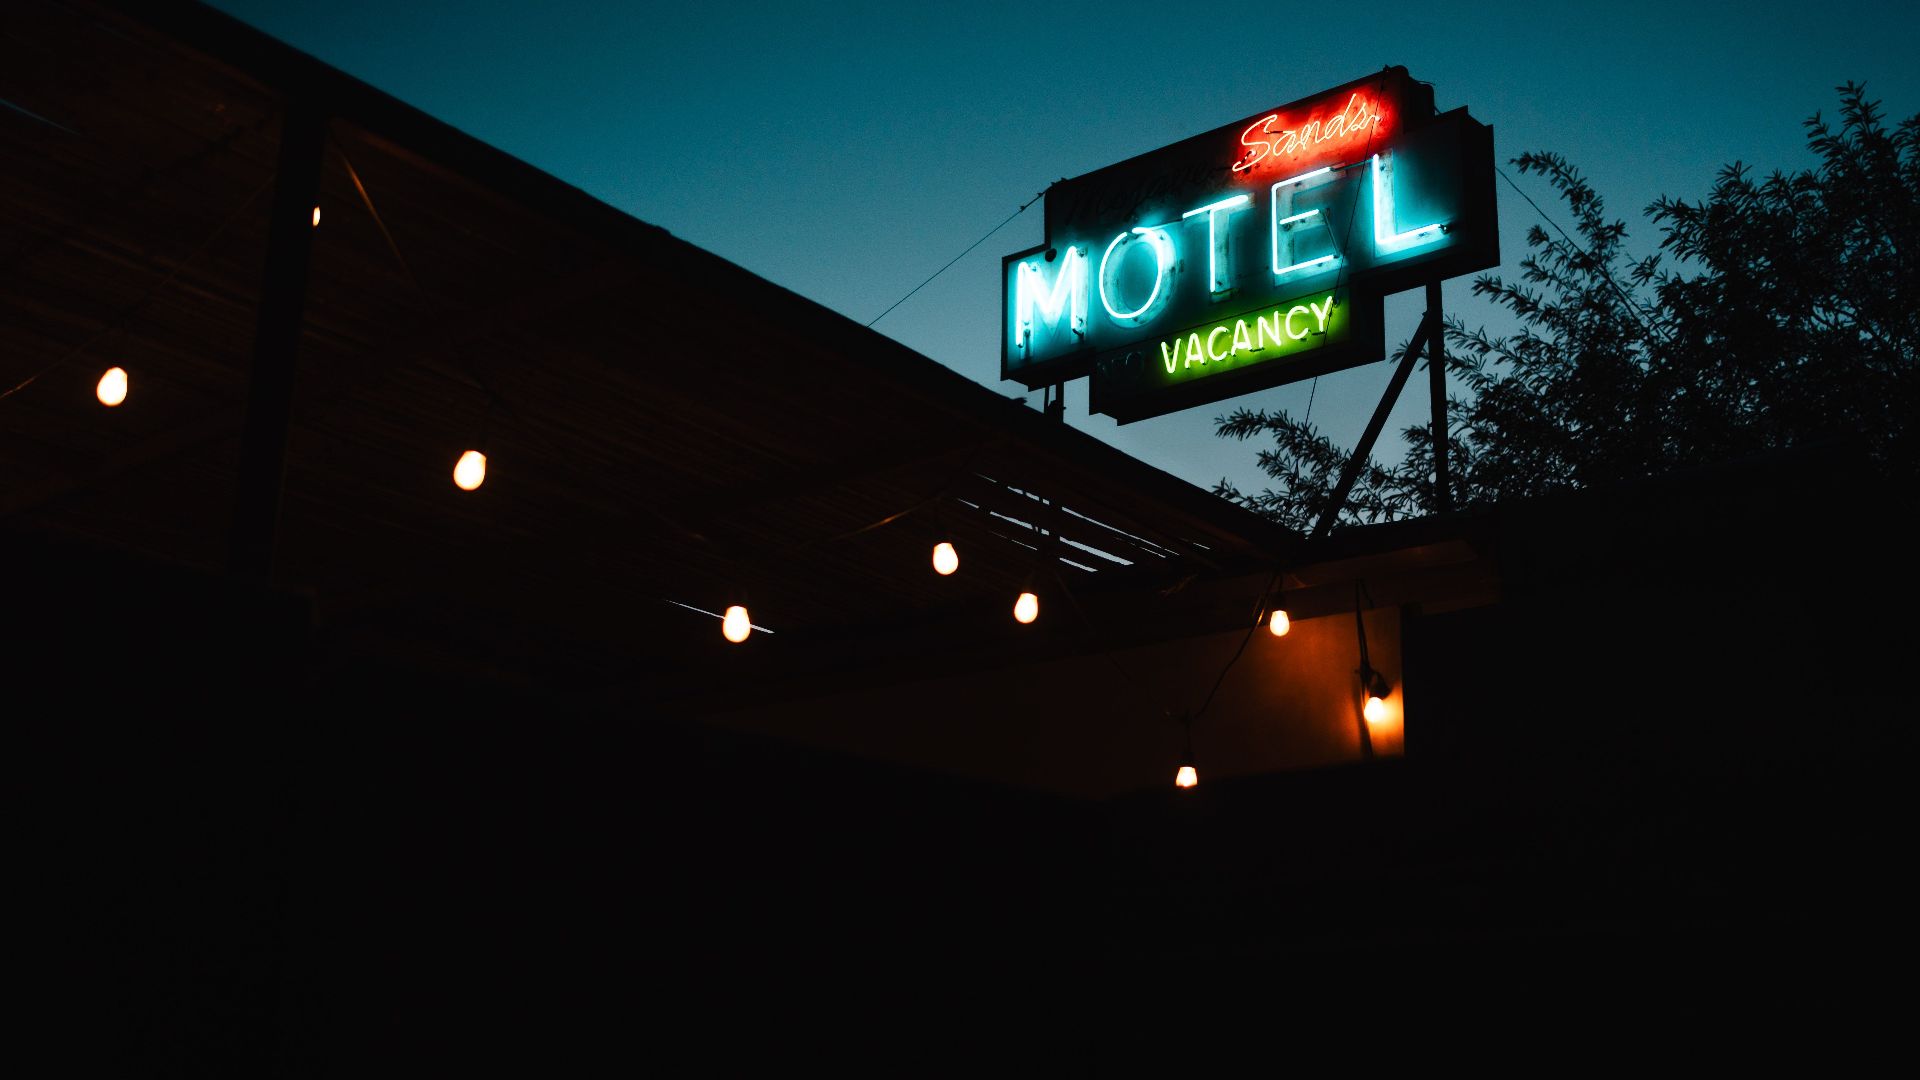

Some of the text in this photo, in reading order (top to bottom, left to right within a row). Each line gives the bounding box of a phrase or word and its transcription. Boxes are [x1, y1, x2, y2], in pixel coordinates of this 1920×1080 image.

[1231, 93, 1381, 172] Sands
[1014, 152, 1446, 350] MOTEL
[1160, 295, 1333, 374] VACANCY
